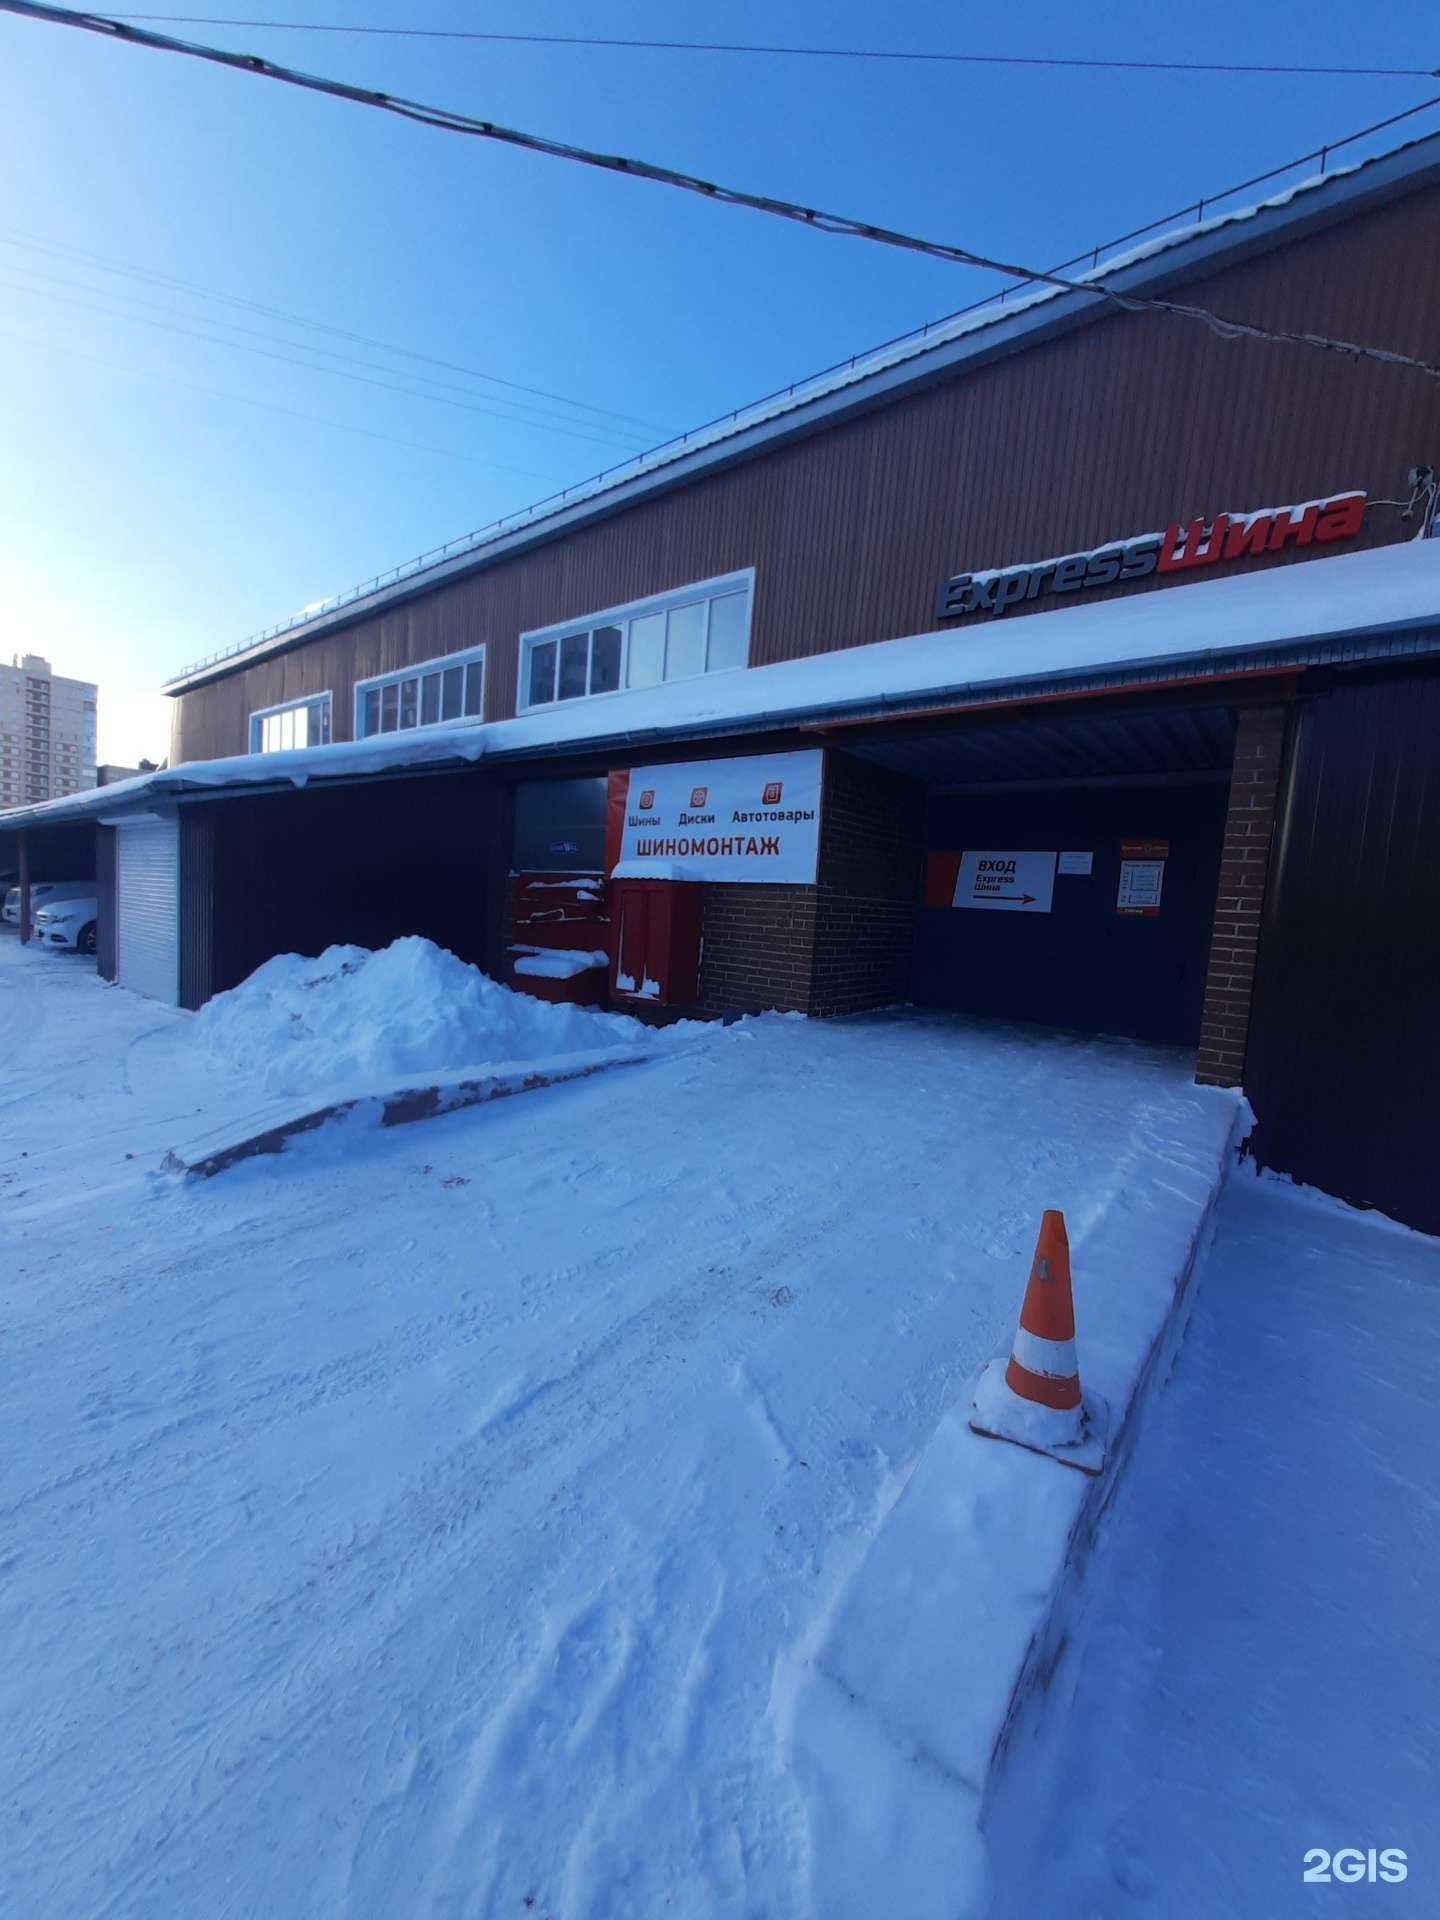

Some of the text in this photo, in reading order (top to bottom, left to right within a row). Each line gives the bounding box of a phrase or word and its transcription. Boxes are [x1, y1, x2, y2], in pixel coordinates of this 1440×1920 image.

[628, 810, 814, 826] Шины Диски Автотовары
[637, 837, 780, 856] ШИНОМОНТАЖ
[978, 860, 1017, 874] ВХОД
[975, 874, 1015, 885] Express
